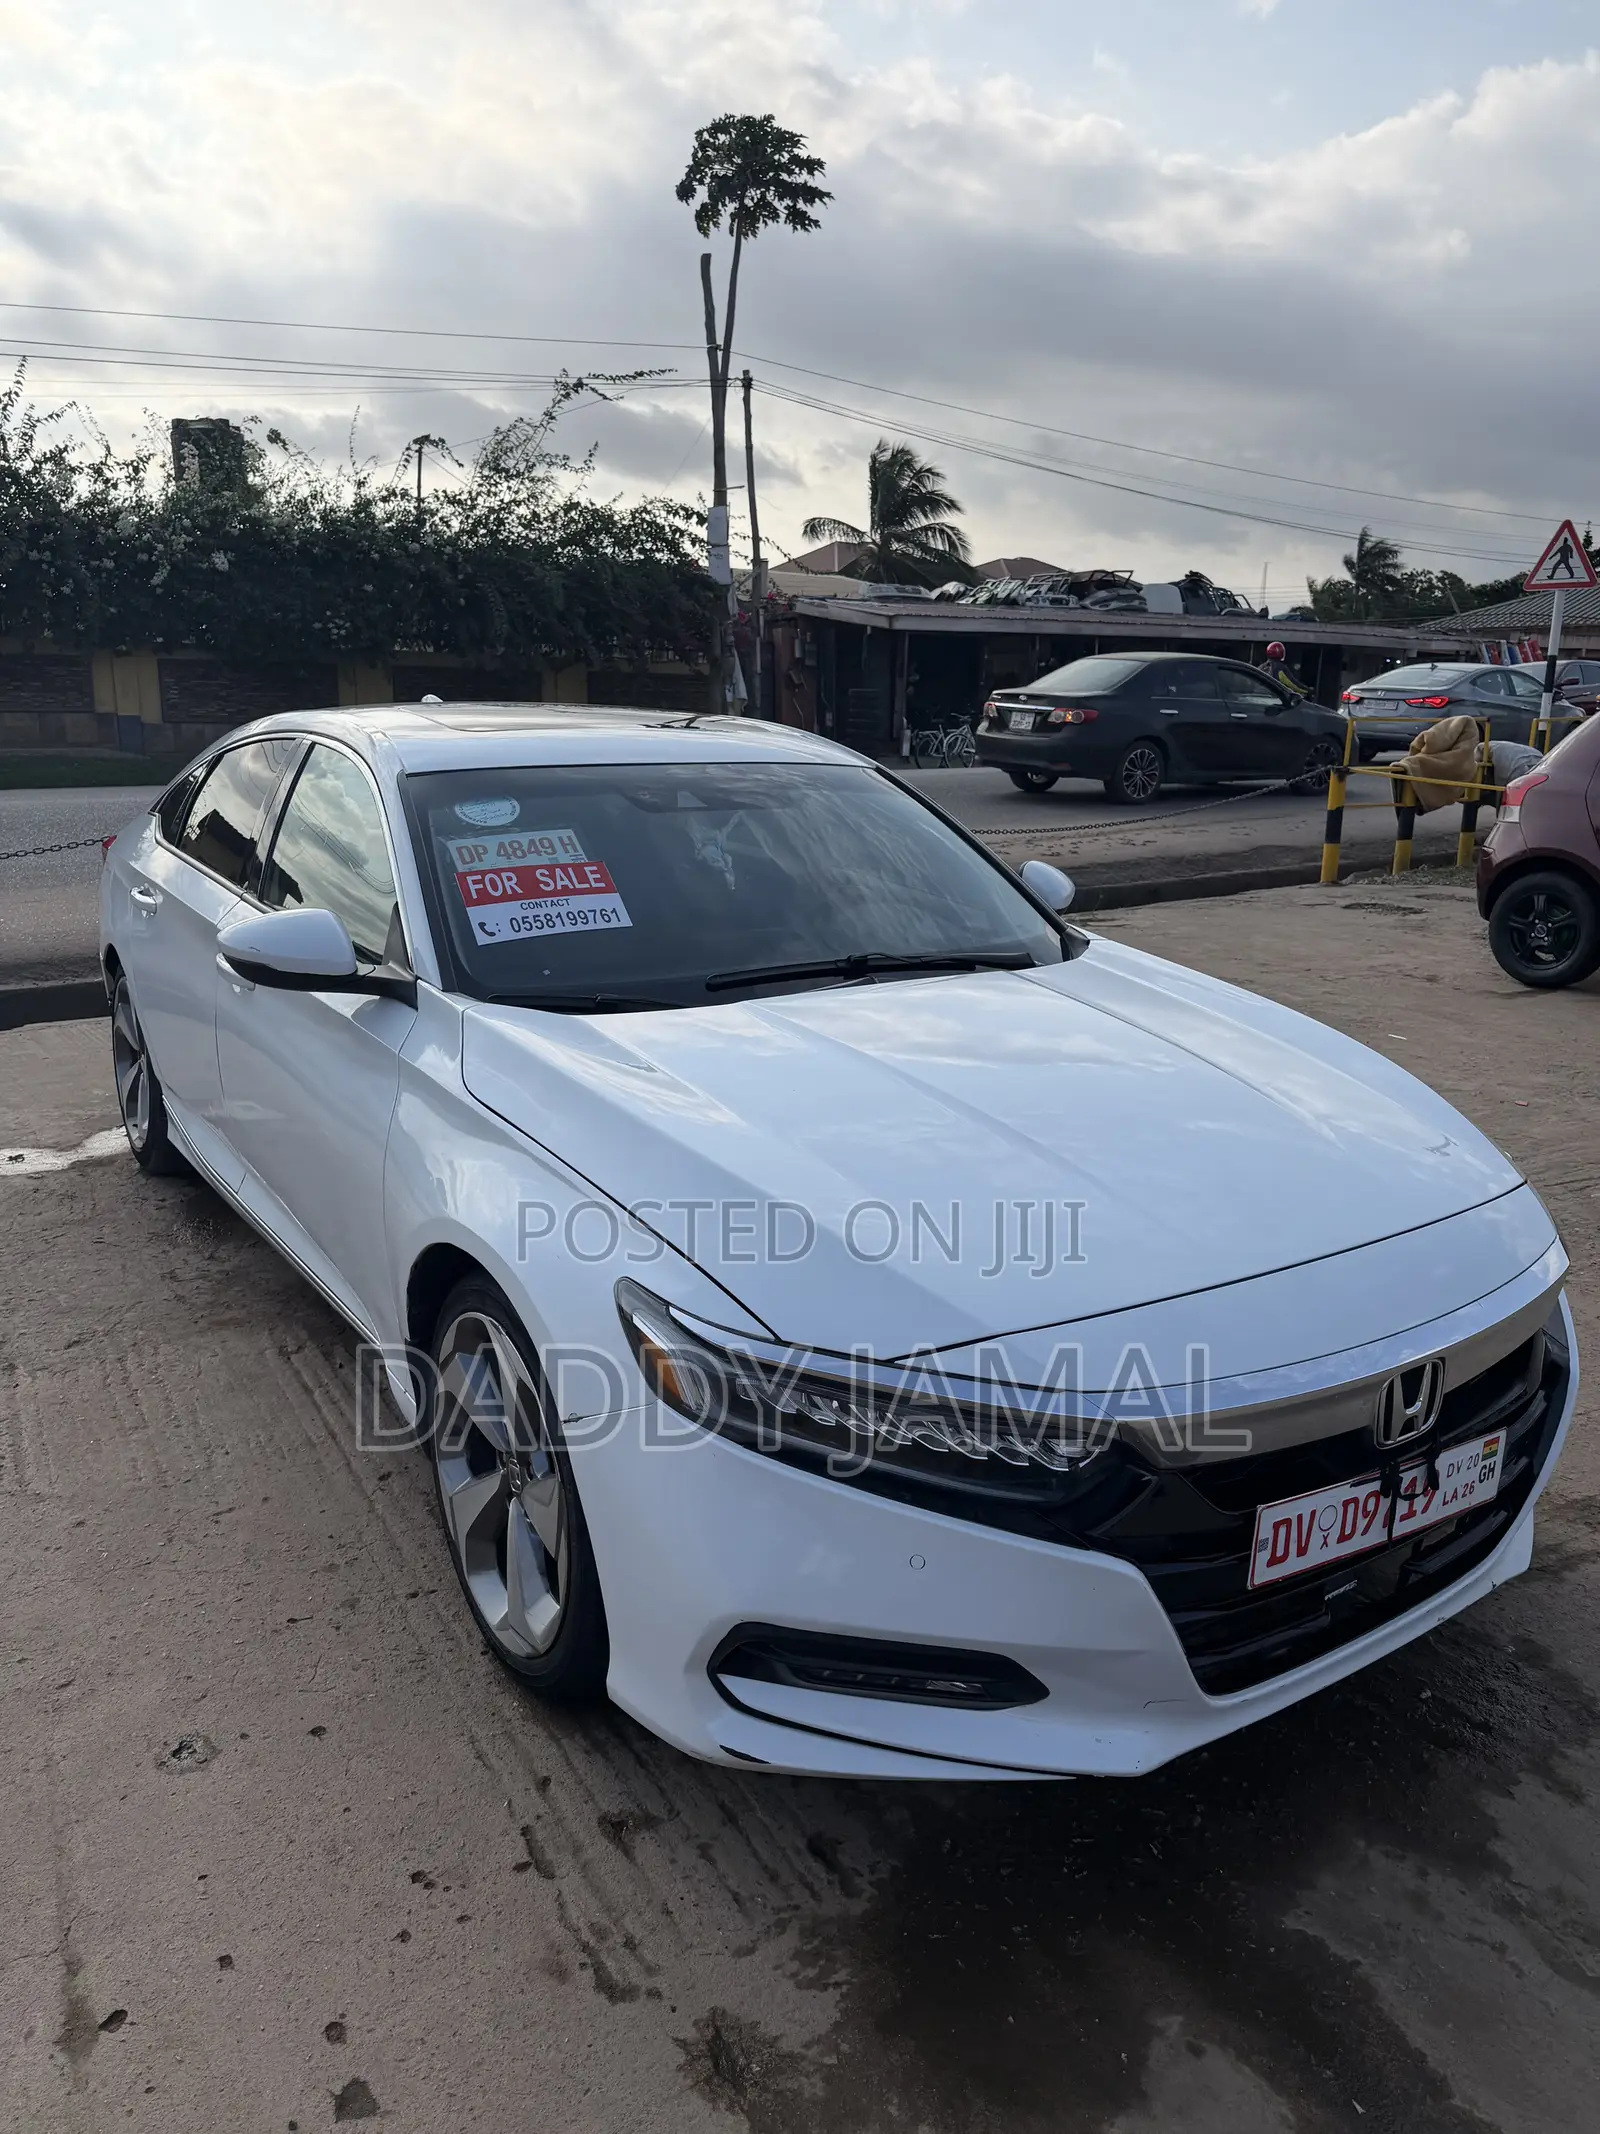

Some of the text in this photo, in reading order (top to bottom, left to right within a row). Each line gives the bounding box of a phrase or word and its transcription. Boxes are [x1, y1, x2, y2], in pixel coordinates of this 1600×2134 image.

[456, 844, 488, 865] DP
[496, 837, 557, 861] 4849
[557, 835, 580, 854] H
[466, 866, 606, 899] FOR SALE
[520, 898, 571, 911] CONTACT
[509, 907, 622, 934] 0558199761
[1446, 1453, 1480, 1478] DV 20
[1478, 1461, 1497, 1483] GH
[1442, 1480, 1475, 1506] LA 26
[1266, 1470, 1440, 1568] DV D919
